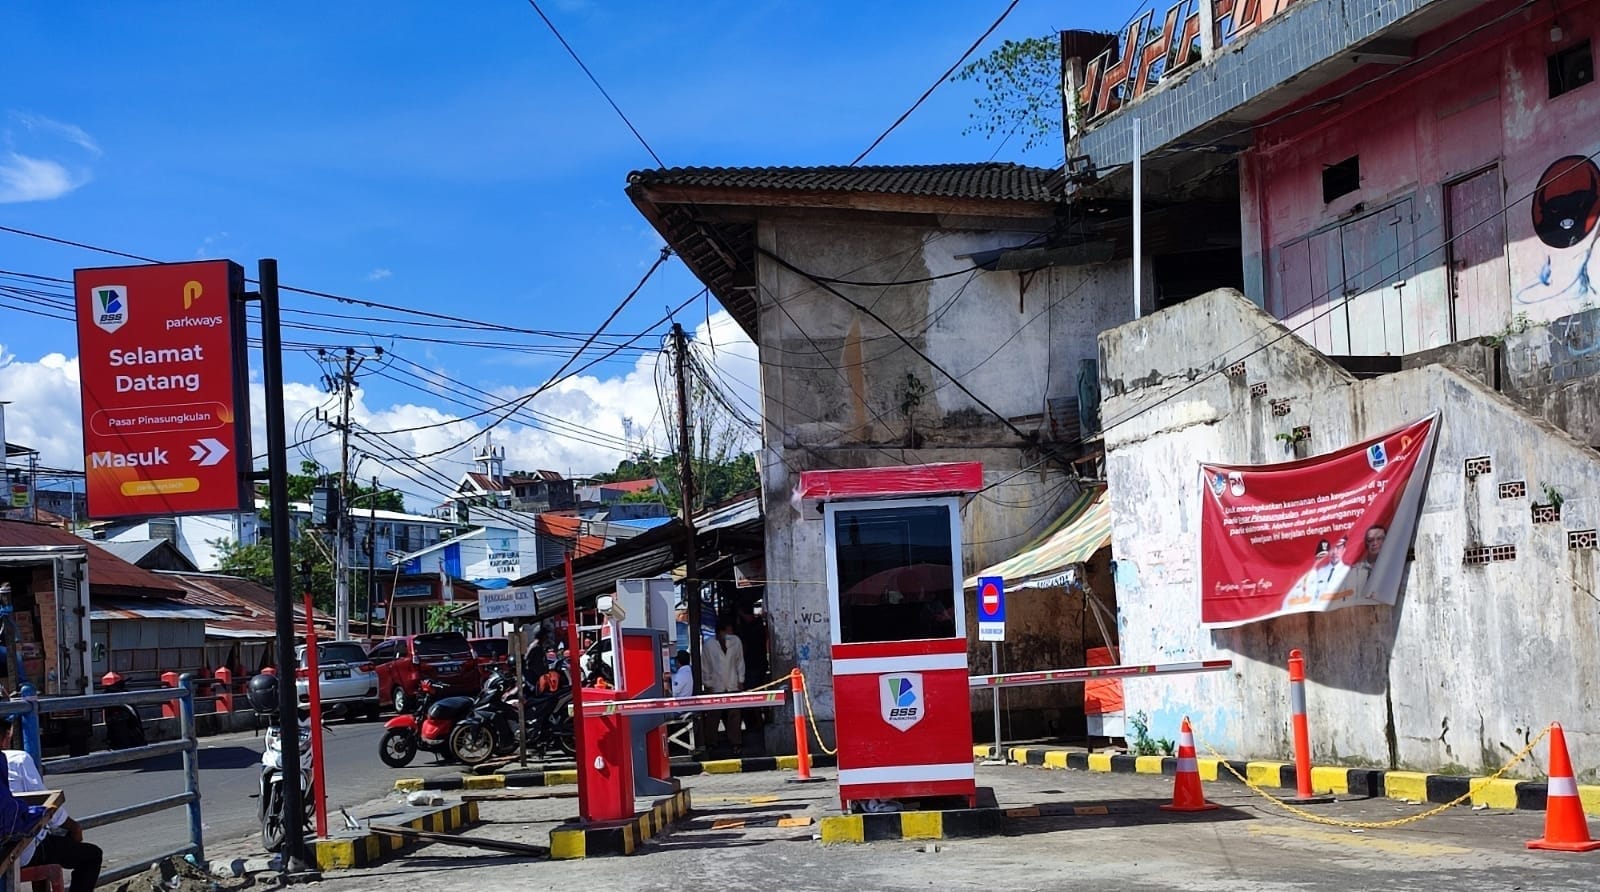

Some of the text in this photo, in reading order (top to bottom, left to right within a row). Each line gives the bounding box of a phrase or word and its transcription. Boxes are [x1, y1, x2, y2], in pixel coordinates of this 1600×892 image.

[166, 316, 222, 331] parkways
[109, 345, 204, 366] Selamat
[116, 373, 199, 392] Datang
[108, 412, 211, 427] Pasar Pinasungkulan
[91, 446, 169, 468] Masuk
[1306, 525, 1332, 535] dengan
[801, 612, 822, 624] WC
[890, 707, 917, 716] BSS
